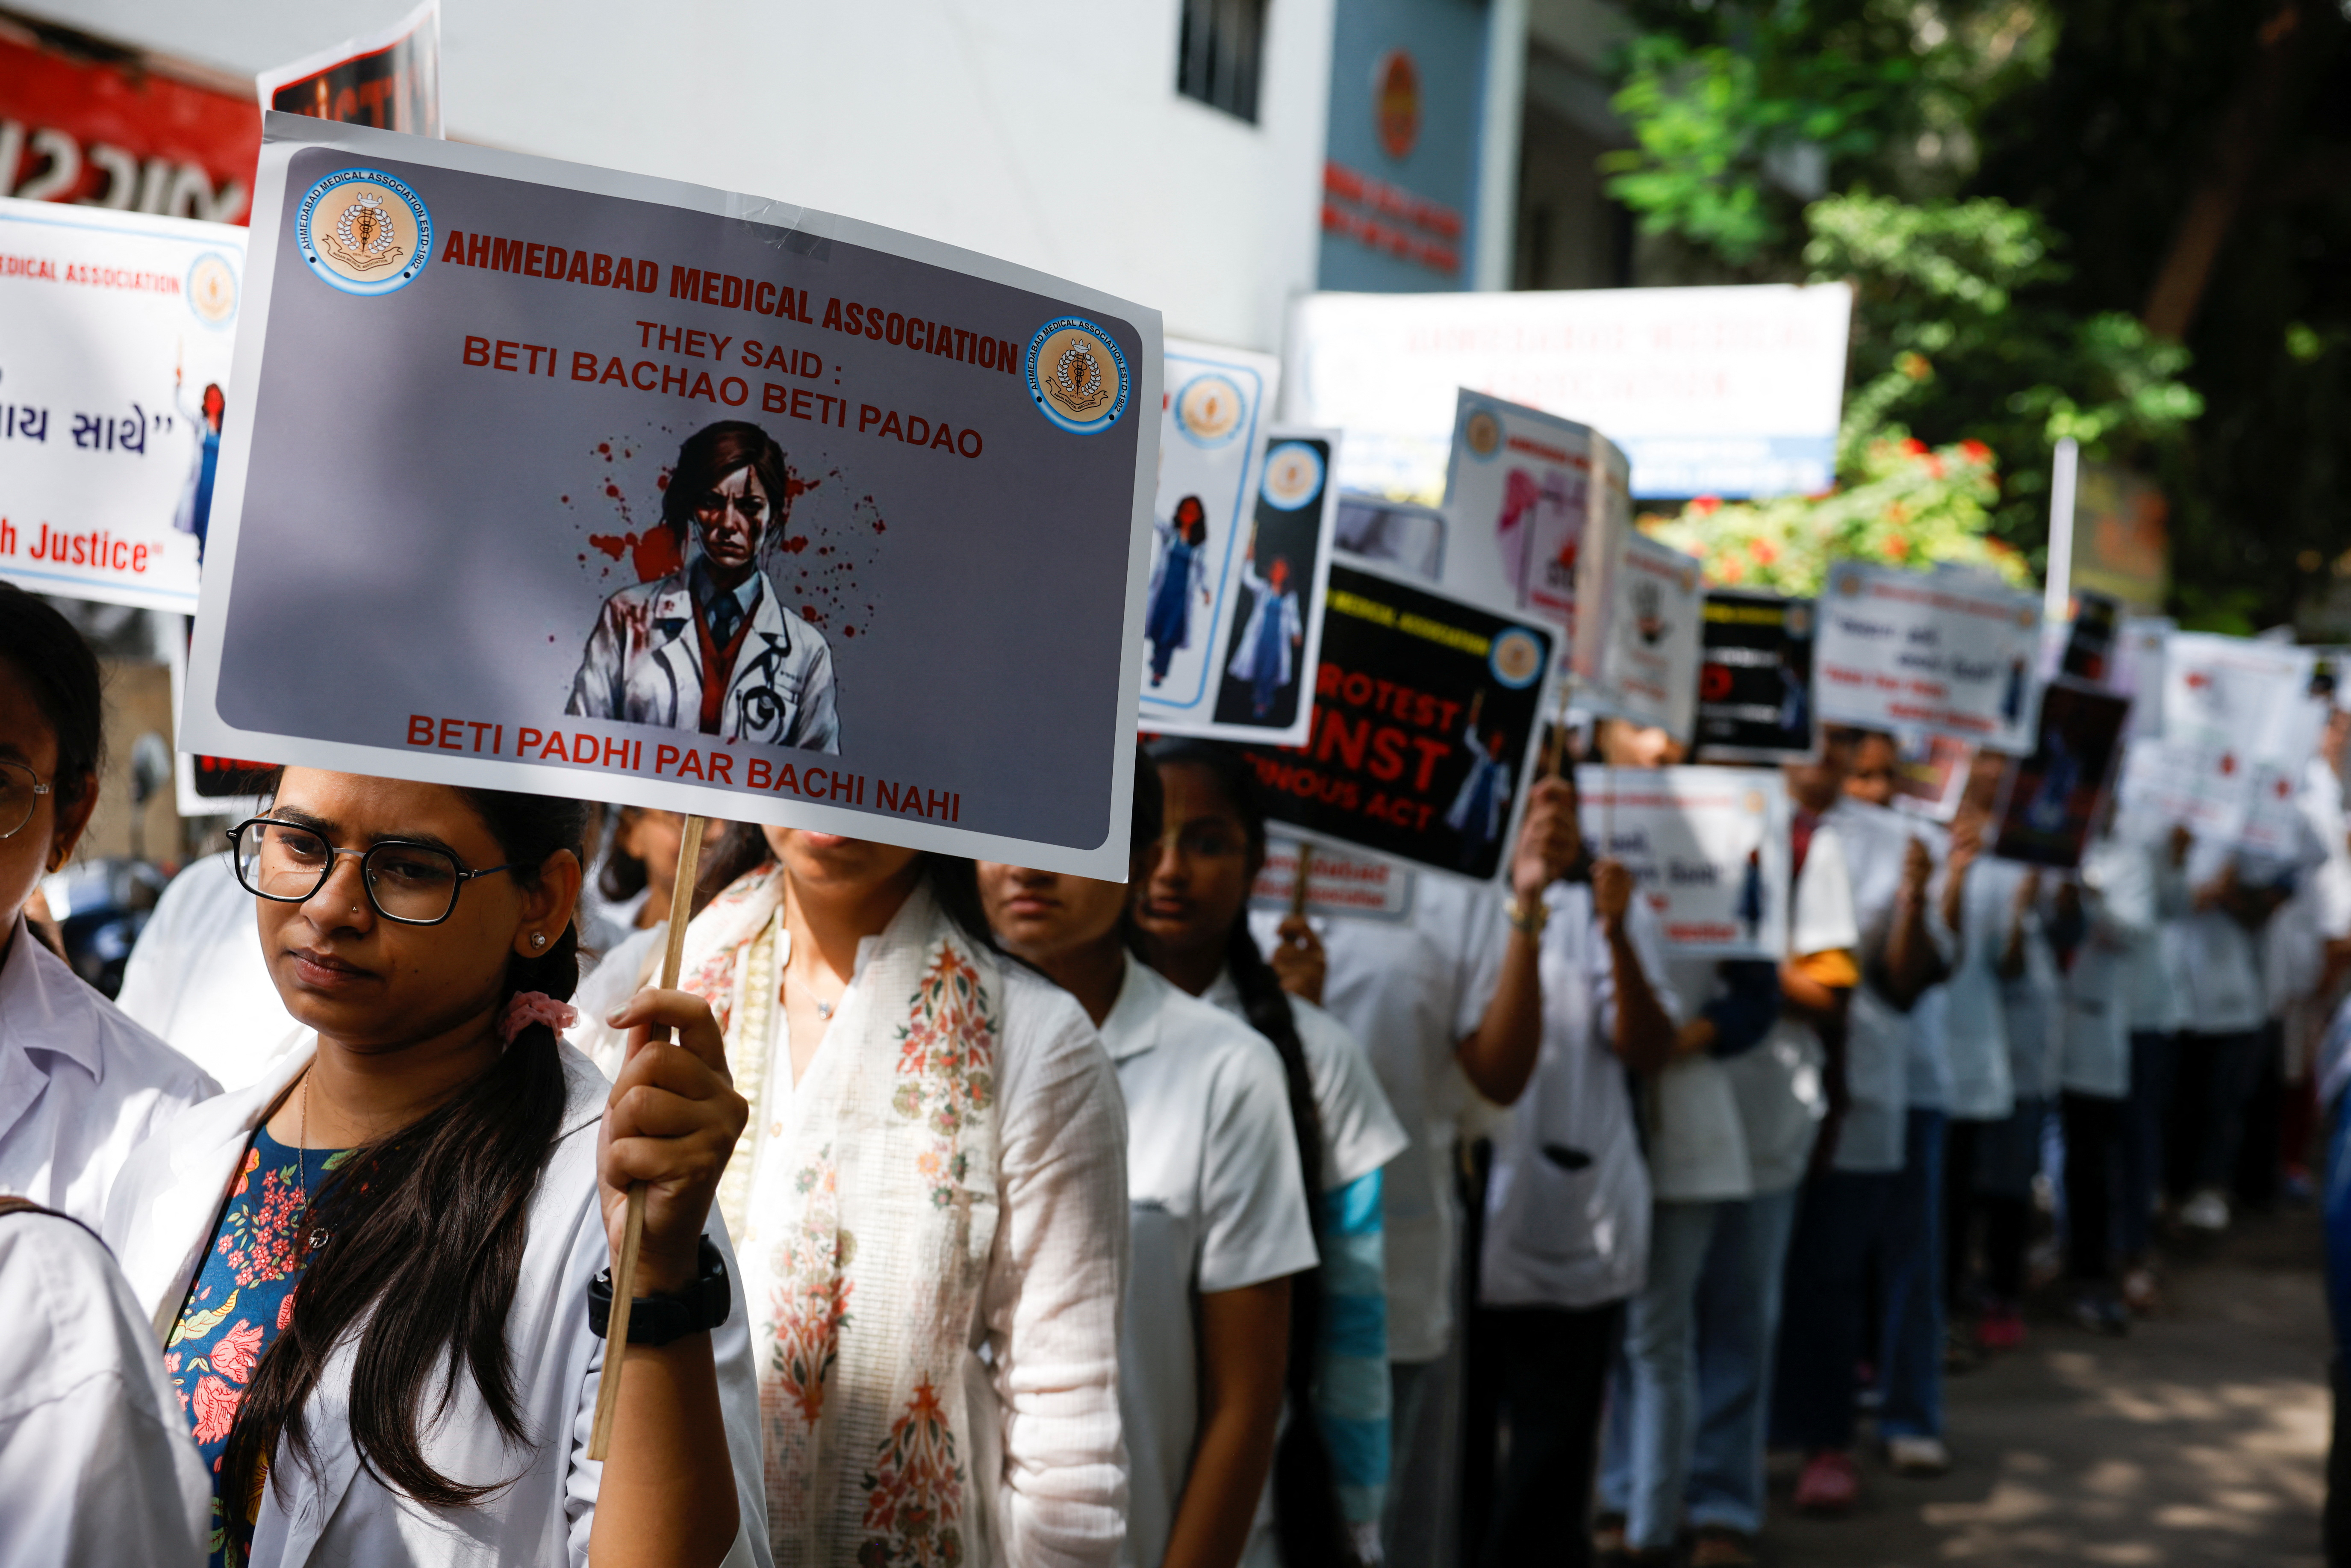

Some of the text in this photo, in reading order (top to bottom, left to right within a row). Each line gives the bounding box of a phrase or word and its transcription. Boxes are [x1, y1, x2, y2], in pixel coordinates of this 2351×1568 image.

[300, 172, 429, 269] AHMEDABAD MEDICAL ASSOCIATION ESTD-1902
[65, 264, 180, 294] ASSOCIATION
[346, 258, 361, 268] MEDICAL
[362, 259, 388, 268] ASSOCIATION
[442, 230, 1017, 374] AHMEDABAD MEDICAL ASSOCIATION
[636, 321, 841, 384] THEY SAID :
[1028, 335, 1043, 389] AHMEDABAD
[1042, 320, 1076, 335] MEDICAL
[1078, 321, 1123, 364] ASSOCIATION
[1114, 367, 1128, 412] ESTD-1902
[463, 336, 982, 457] BETI BACHAO BETI PADAO
[1065, 398, 1077, 409] MEDICAL
[1317, 661, 1462, 733] ROTEST
[407, 715, 959, 821] BETI PADHI PAR BACHI NAHI
[1364, 791, 1438, 834] ACT
